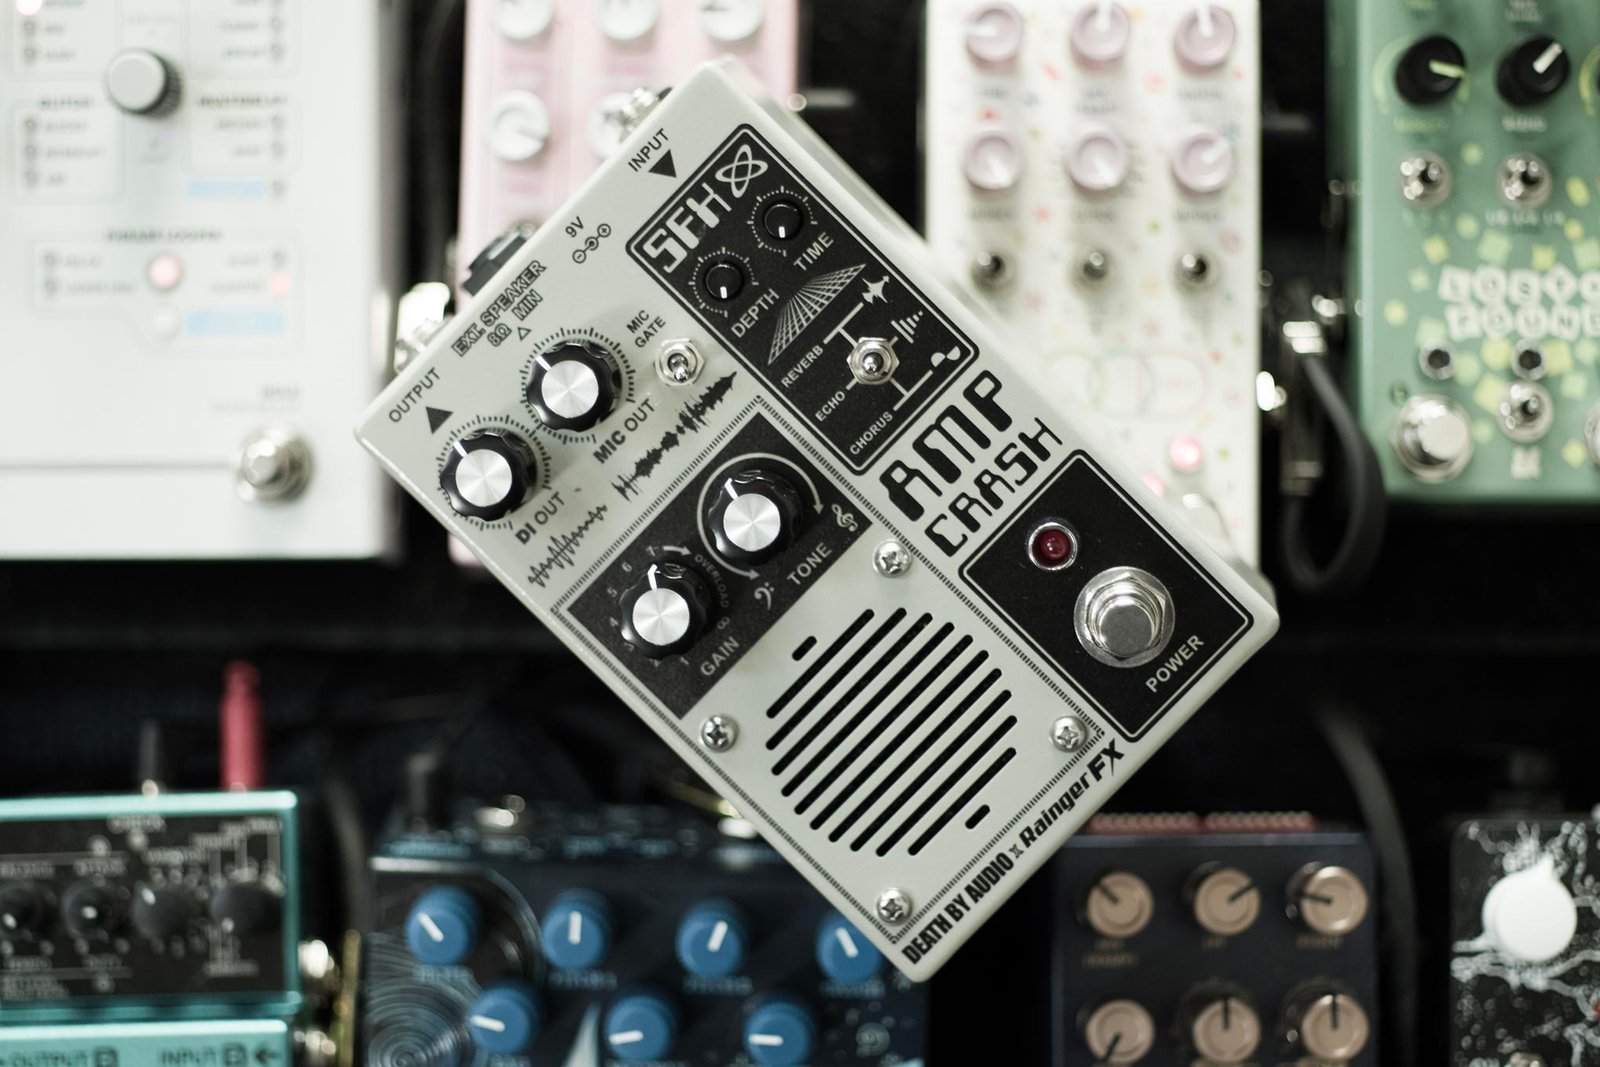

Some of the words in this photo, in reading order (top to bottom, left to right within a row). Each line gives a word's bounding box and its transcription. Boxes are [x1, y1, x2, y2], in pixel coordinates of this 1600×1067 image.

[627, 128, 670, 173] INPUT
[565, 216, 585, 239] 9V
[642, 182, 732, 274] SFH
[793, 232, 834, 271] TIME
[451, 322, 485, 357] EXT.
[481, 260, 547, 326] SPEAKER
[512, 289, 543, 321] MIN
[626, 310, 650, 334] MIC
[730, 288, 780, 338] DEPTH
[634, 316, 666, 348] GATE
[780, 345, 824, 388] REVERB
[388, 367, 441, 423] OUTPUT
[814, 390, 846, 422] ECHO
[593, 430, 626, 464] MIC
[623, 398, 656, 432] OUT
[849, 411, 893, 456] CHORUS
[879, 370, 1013, 521] AMP
[924, 417, 1063, 557] CRASH
[515, 522, 537, 544] DI
[534, 492, 565, 525] OUT
[621, 562, 633, 572] 6
[694, 554, 730, 608] OVERLOAD
[786, 542, 832, 586] TONE
[607, 586, 618, 598] 5
[609, 617, 619, 627] 4
[700, 636, 740, 675] GAIN
[1145, 634, 1205, 692] POWER
[902, 914, 953, 964] DEATH
[946, 893, 972, 923] BY
[964, 853, 1014, 903] AUDIO
[1019, 772, 1090, 848] Rainger
[1087, 738, 1125, 782] FX
